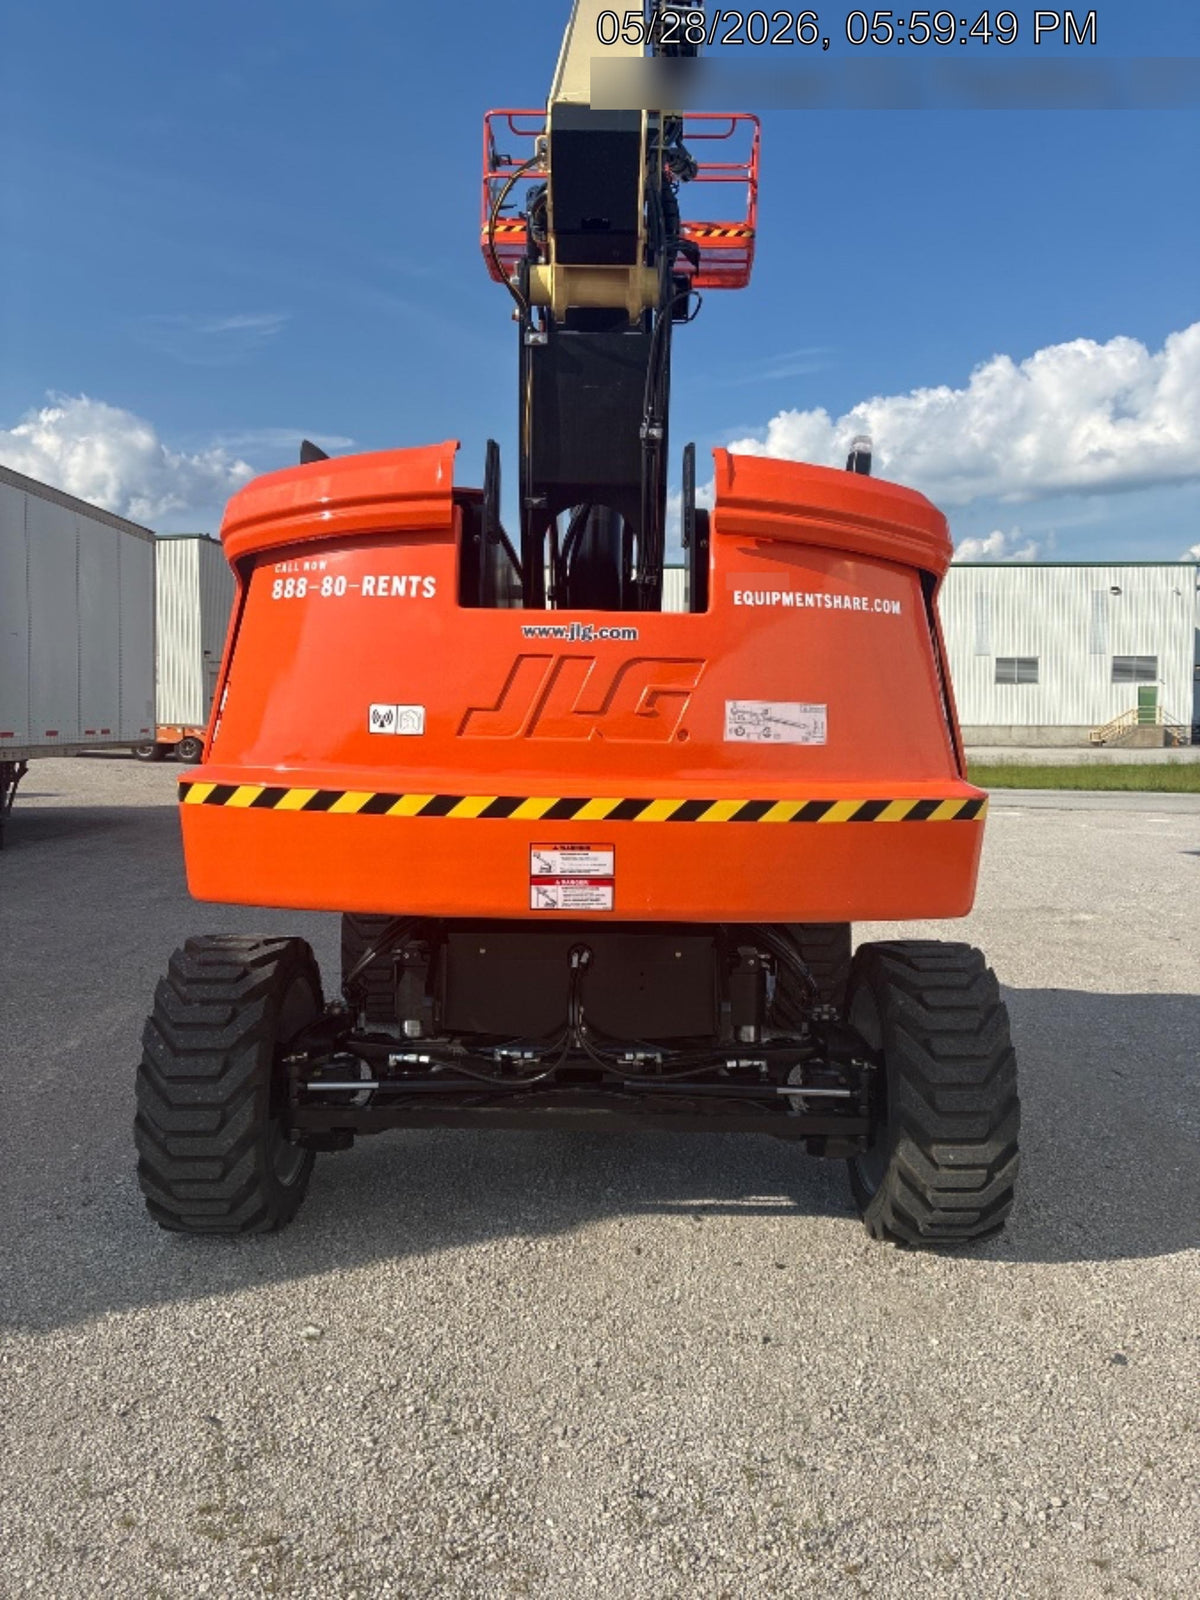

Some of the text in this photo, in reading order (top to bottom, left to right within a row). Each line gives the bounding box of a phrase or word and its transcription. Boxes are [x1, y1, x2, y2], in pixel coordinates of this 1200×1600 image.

[274, 561, 328, 573] CALL NOW
[271, 575, 437, 599] 888-80-RENTS
[733, 590, 901, 615] EQUIPMENTSHARE.COM
[521, 623, 639, 641] www.jlg.com
[457, 653, 709, 744] JLG
